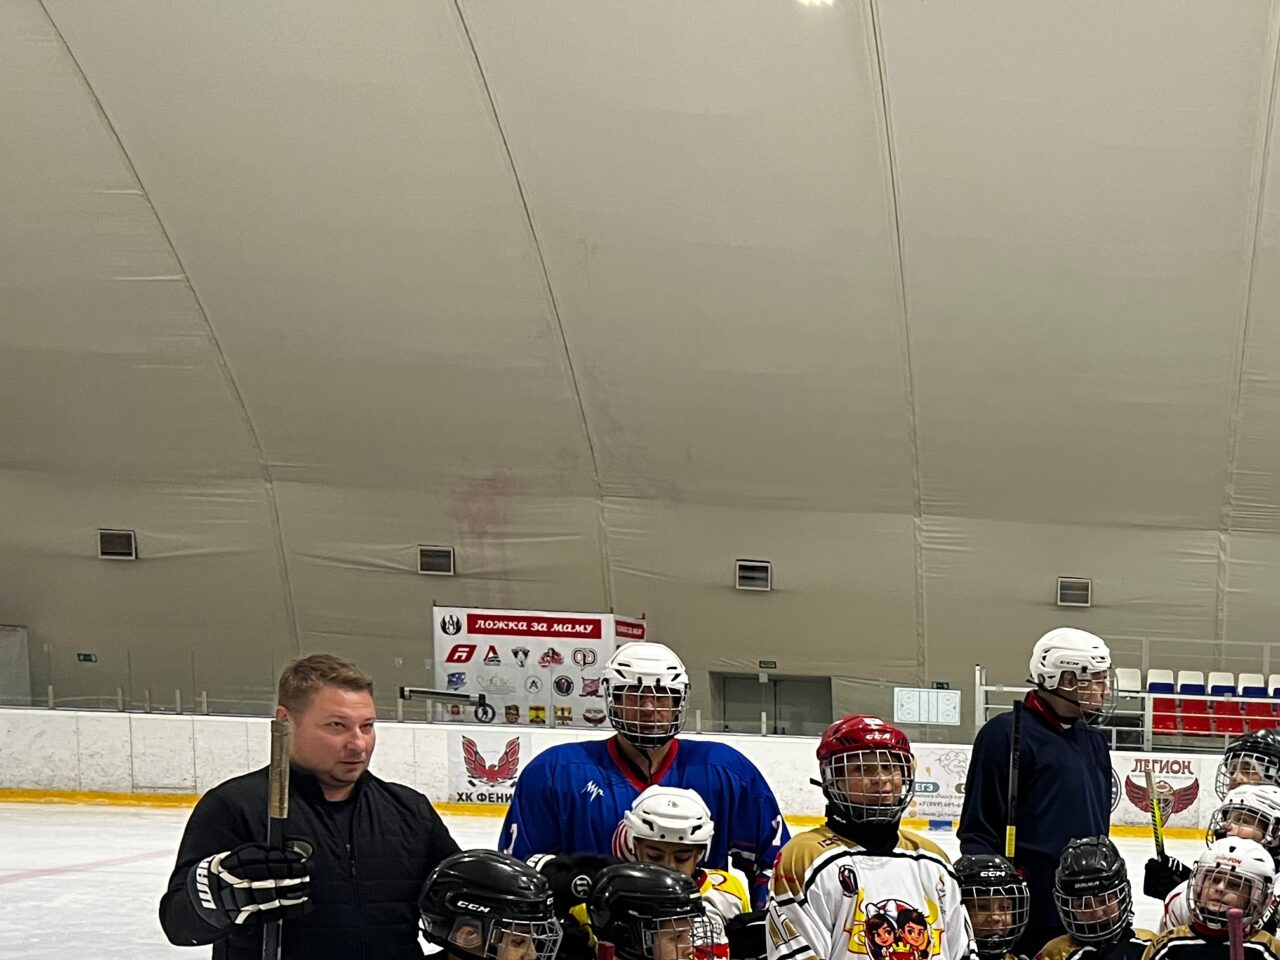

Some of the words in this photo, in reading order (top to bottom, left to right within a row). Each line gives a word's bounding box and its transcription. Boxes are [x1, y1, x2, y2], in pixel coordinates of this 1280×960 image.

[475, 618, 527, 631] ложка
[531, 622, 547, 632] за
[551, 624, 594, 634] маму
[1131, 758, 1194, 775] ЛЕГИОН
[915, 783, 933, 791] ЕГЭ
[456, 791, 473, 804] ХК
[456, 900, 491, 913] CCM
